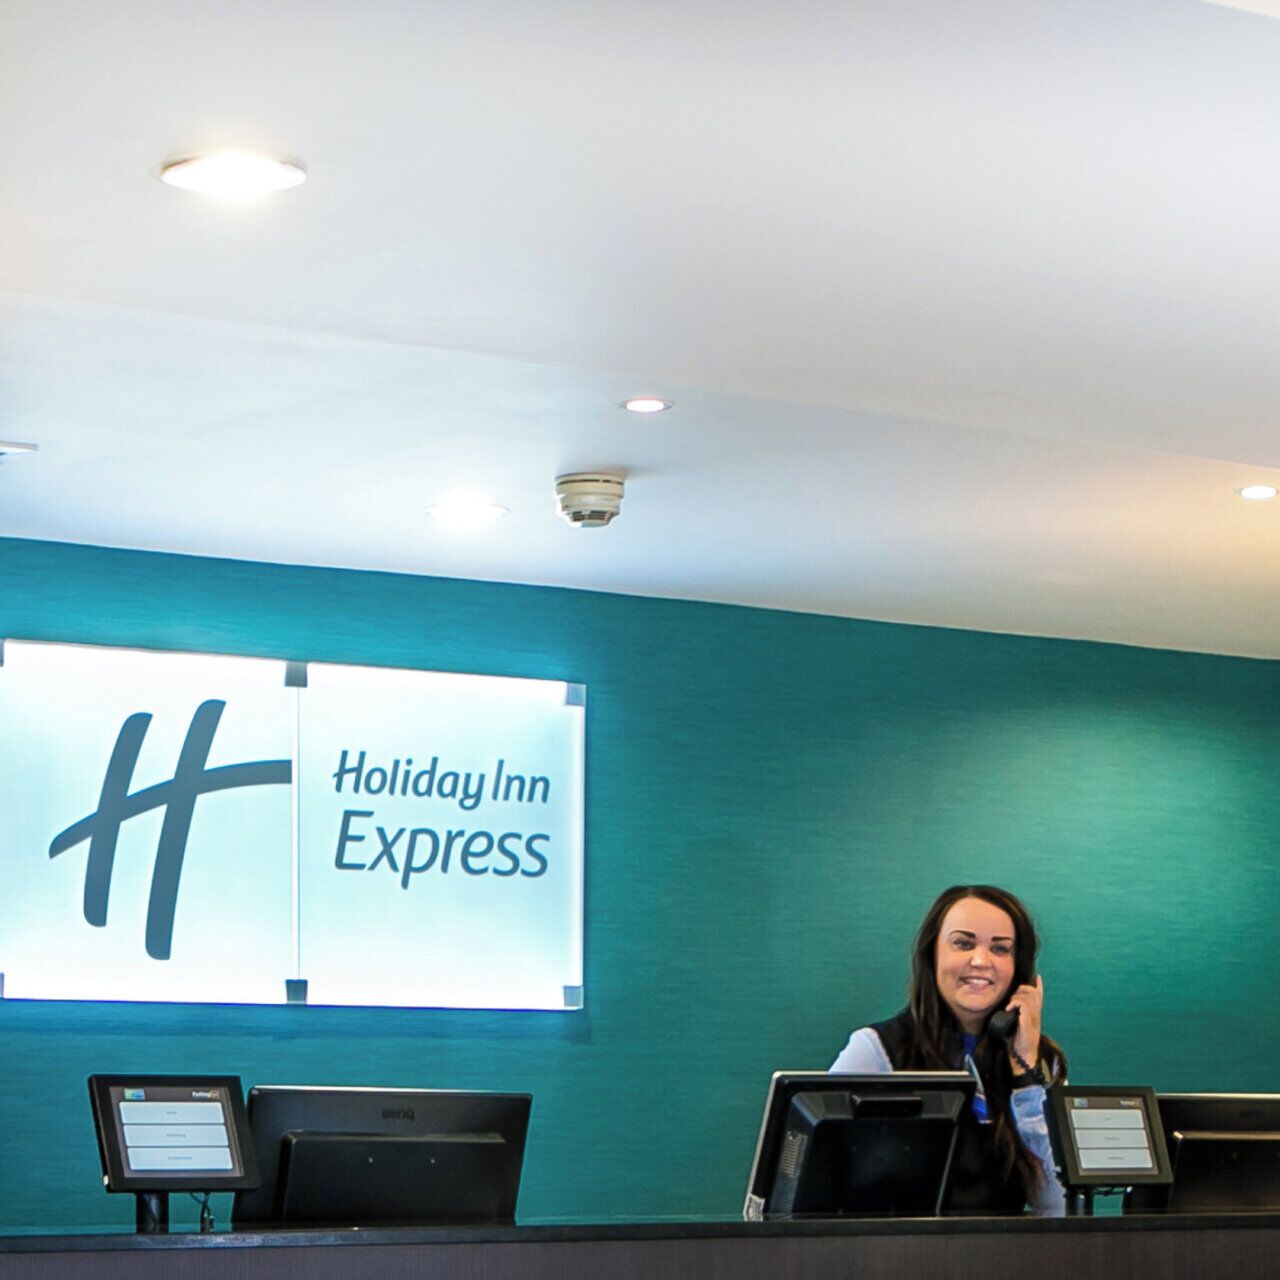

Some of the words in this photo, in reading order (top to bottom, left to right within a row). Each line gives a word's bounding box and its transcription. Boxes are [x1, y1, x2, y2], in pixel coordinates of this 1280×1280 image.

[333, 750, 486, 810] Holiday
[492, 760, 550, 803] Inn
[335, 810, 550, 889] Express
